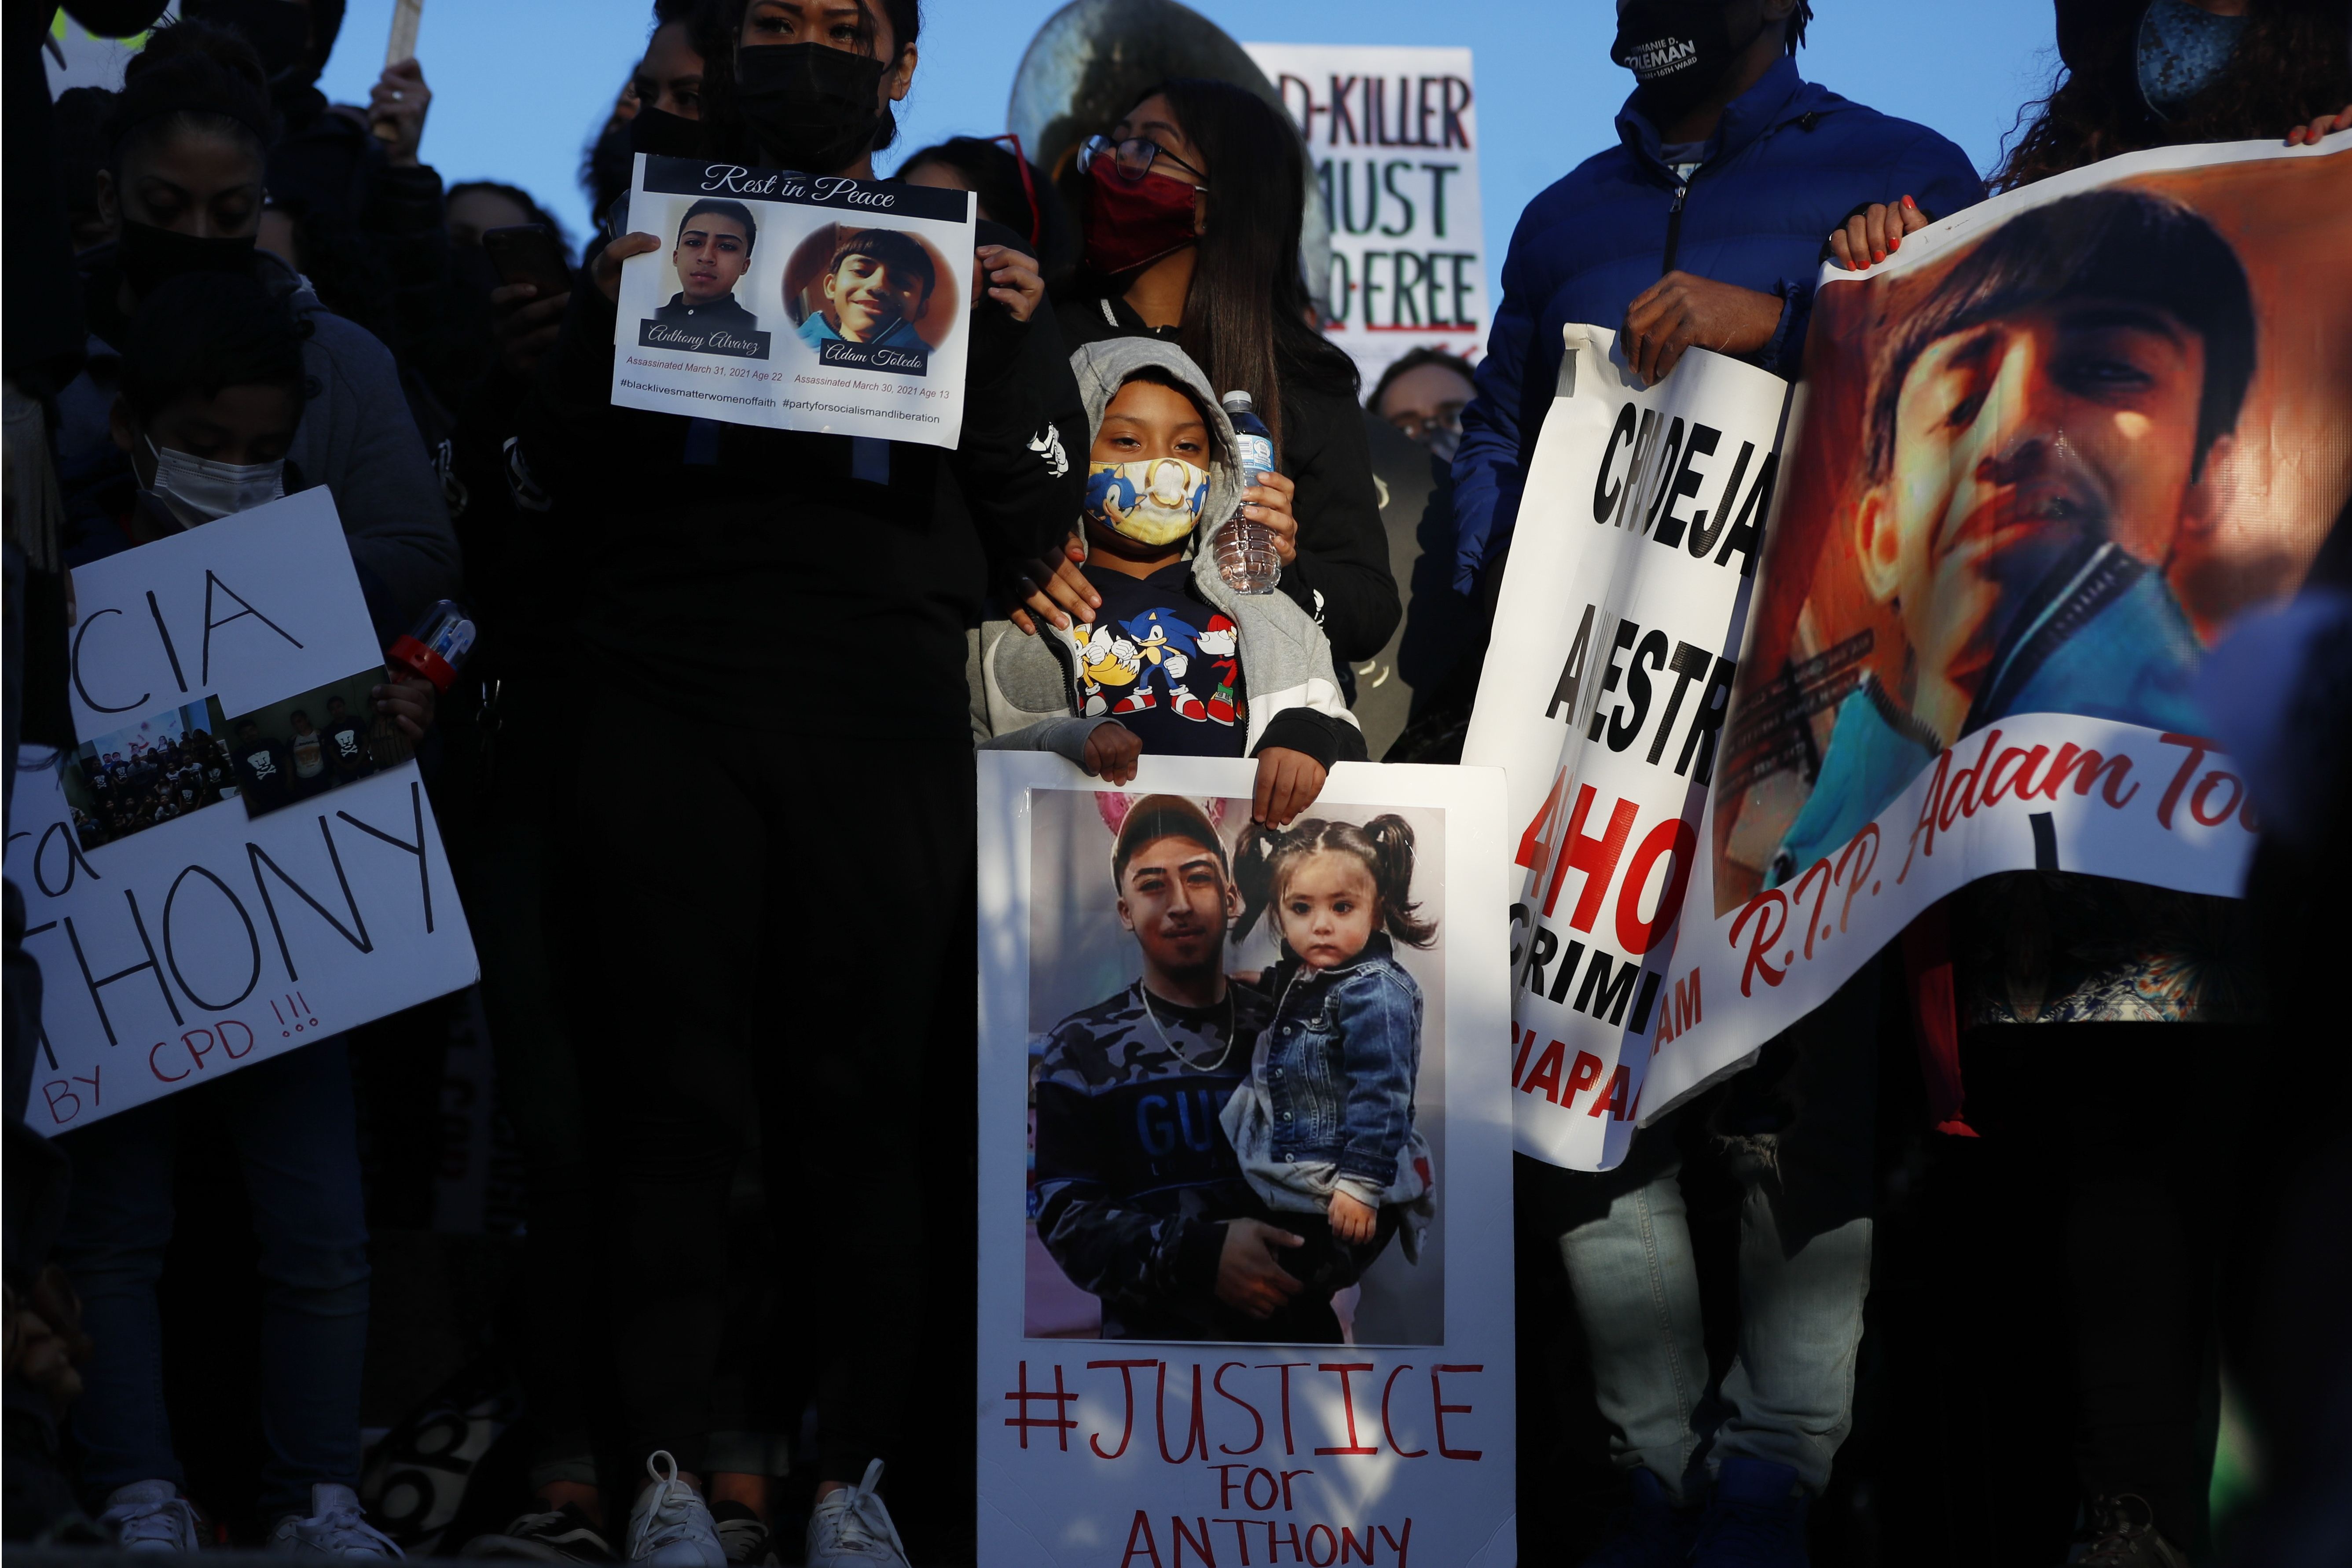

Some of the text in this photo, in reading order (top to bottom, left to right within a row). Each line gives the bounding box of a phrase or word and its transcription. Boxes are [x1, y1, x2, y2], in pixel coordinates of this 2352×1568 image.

[1624, 40, 1696, 70] COLEMAN
[1656, 67, 1674, 77] 16TH
[1674, 56, 1698, 71] WARD
[701, 164, 895, 207] Rest in Peace
[648, 325, 760, 356] Anthony Alvarez
[825, 344, 923, 369] Adam Toledo
[626, 356, 783, 382] Assassinated March 31, 2021 Age 22
[794, 374, 950, 399] Assassinated March 30, 2021 Age 13
[620, 378, 940, 424] #blacklivesmatterwomenoffaith #partyforsocialismandliberation
[71, 569, 304, 713] CIA
[1729, 822, 1881, 998] R.I.P.
[1897, 729, 2141, 885] Adam
[42, 1065, 100, 1125] BY
[149, 1020, 254, 1083] CPD
[1512, 1021, 1645, 1122] IAPA
[1137, 1089, 1232, 1157] GU
[1004, 1359, 1485, 1465] #JUSTICE
[1120, 1509, 1413, 1568] ANTHONY
